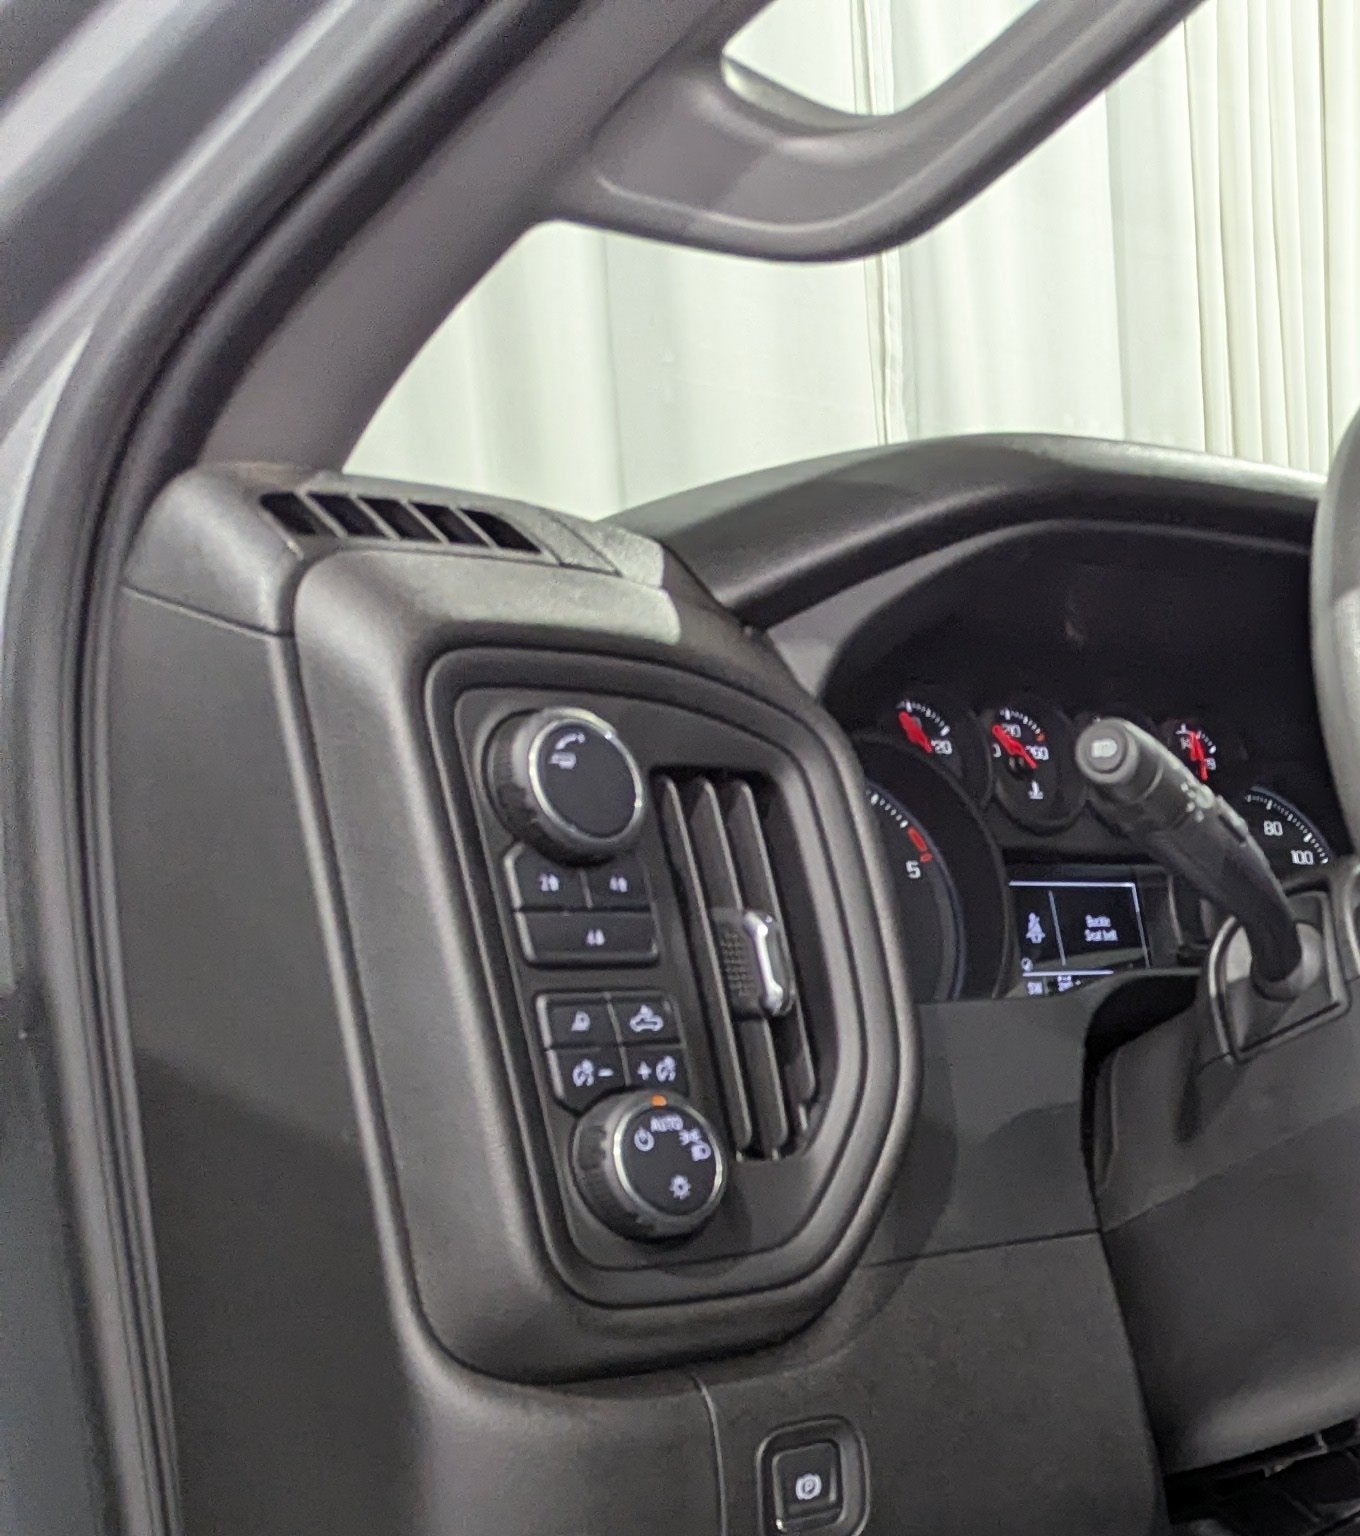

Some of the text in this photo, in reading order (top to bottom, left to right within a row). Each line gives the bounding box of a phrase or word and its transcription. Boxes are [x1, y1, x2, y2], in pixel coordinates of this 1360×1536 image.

[1263, 820, 1283, 837] 80
[1290, 849, 1314, 866] 100
[905, 860, 921, 879] 5
